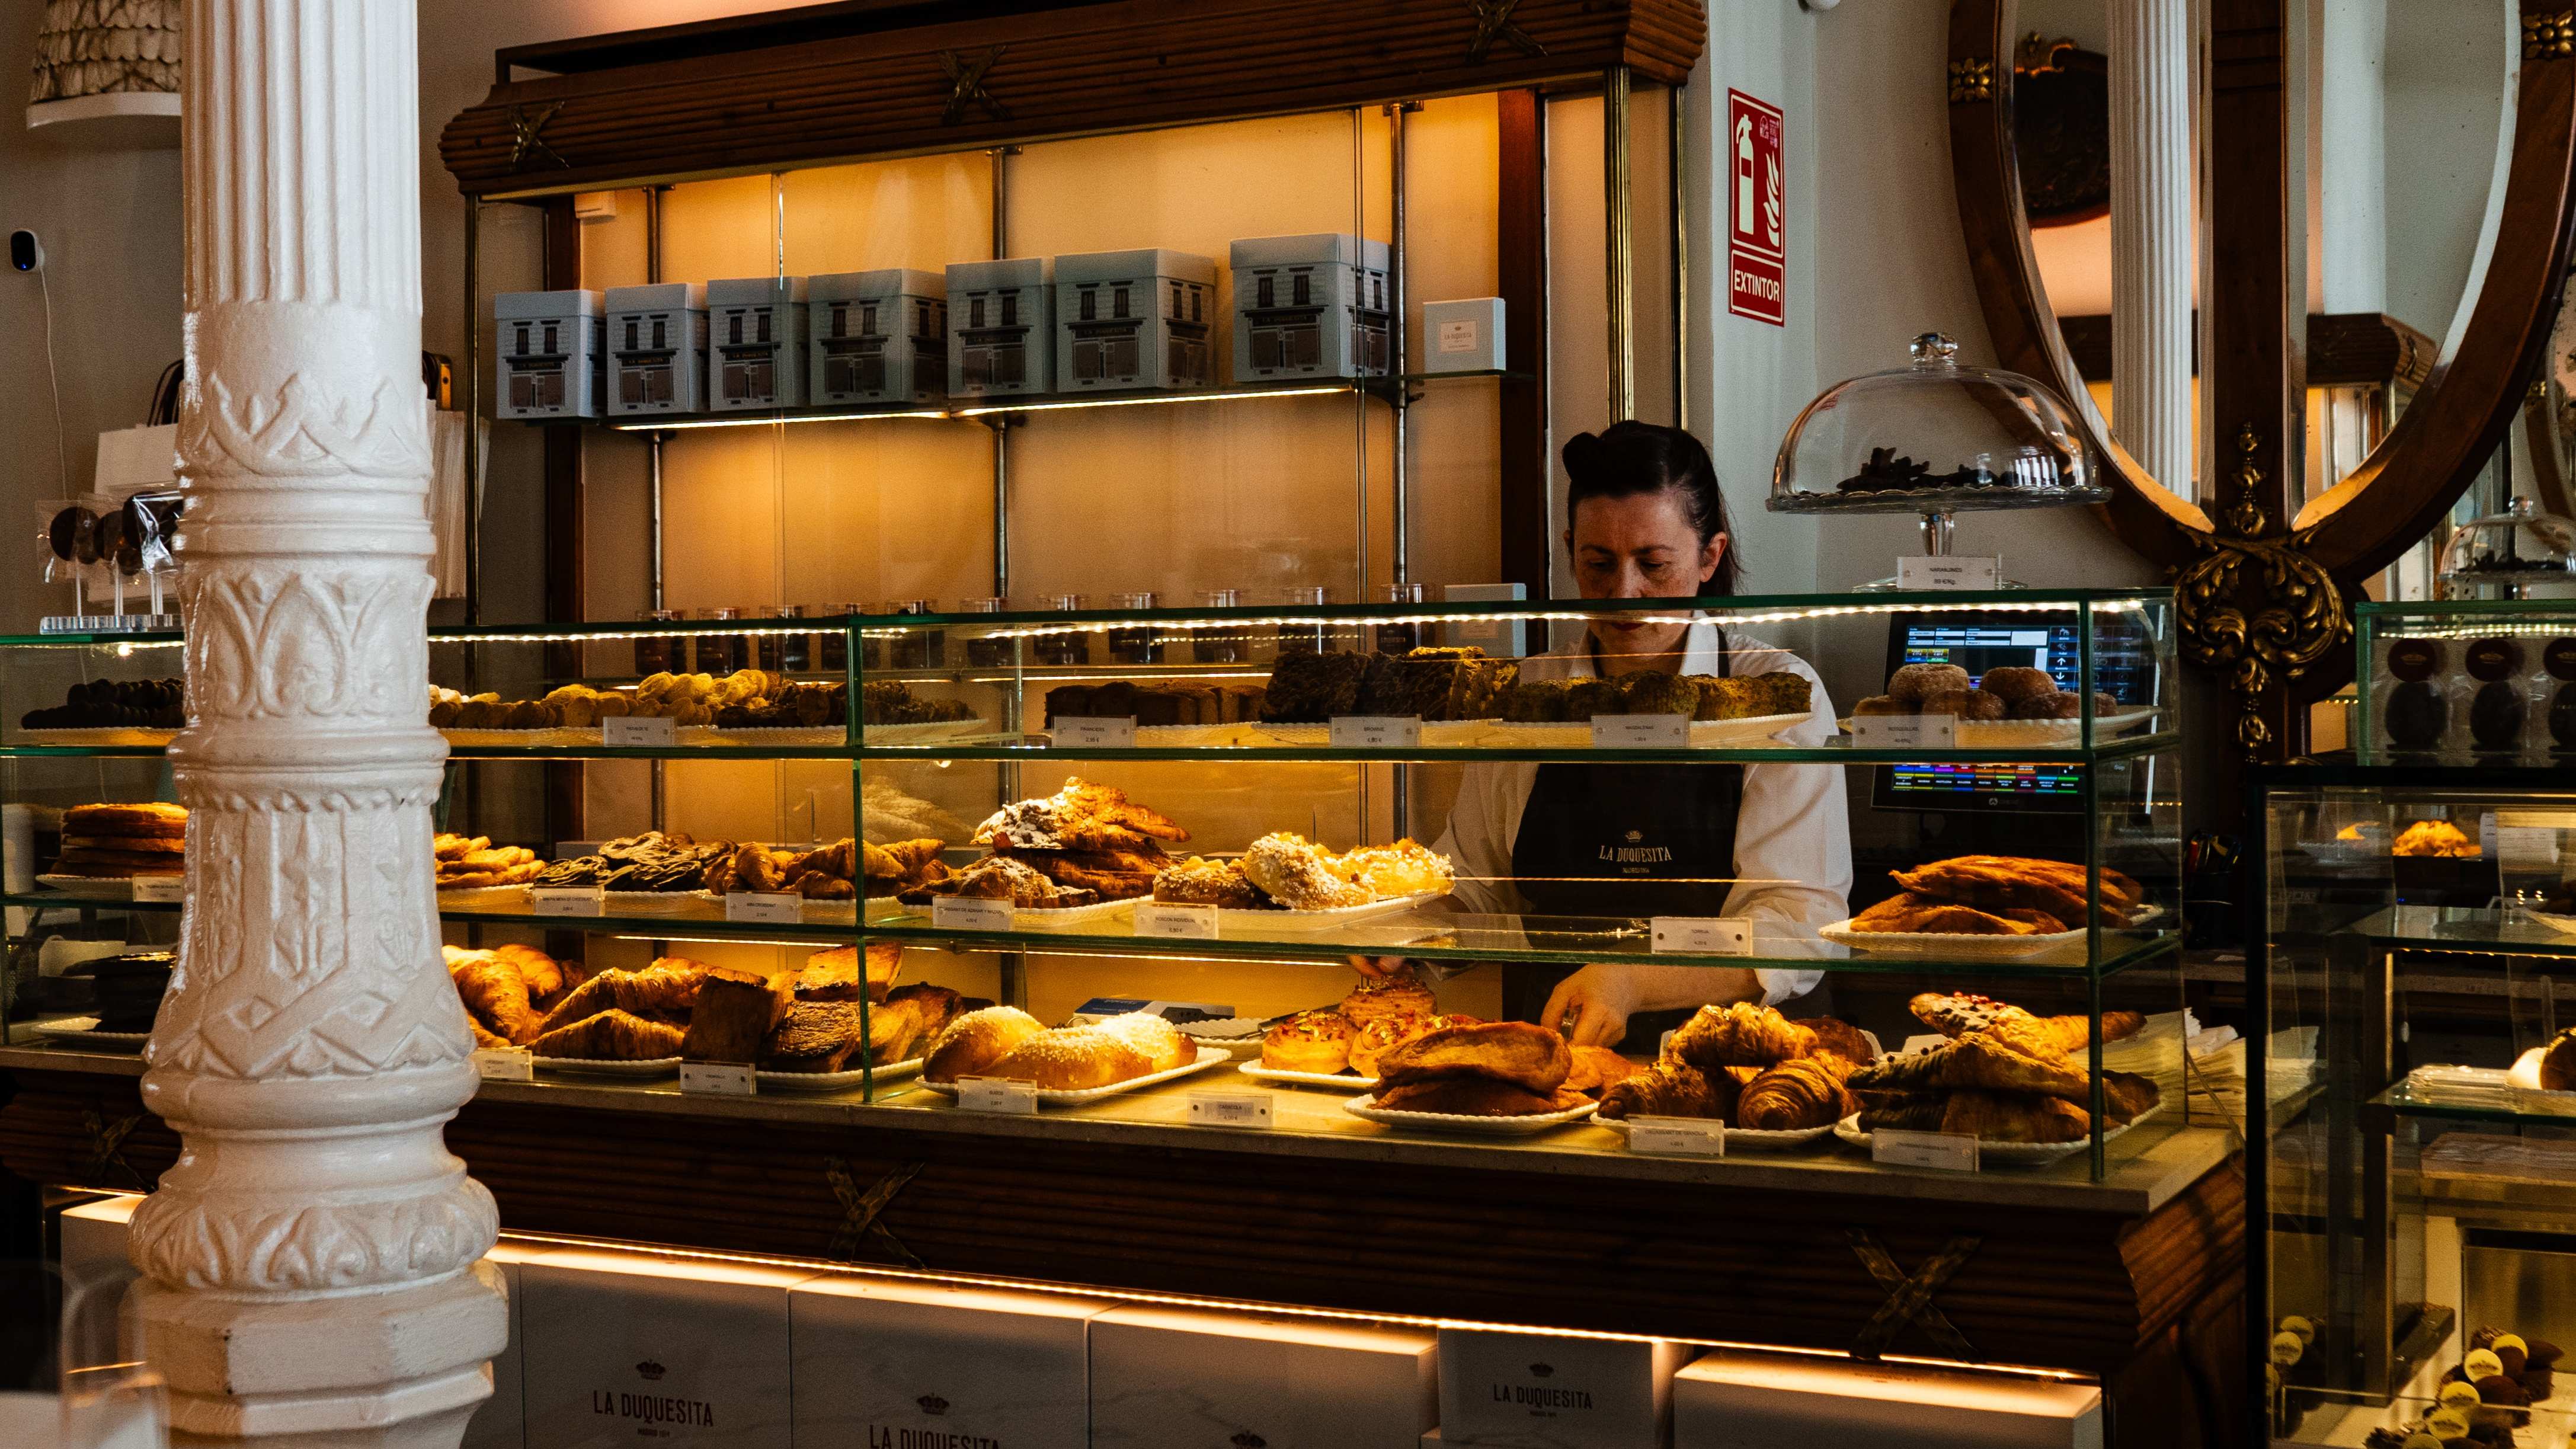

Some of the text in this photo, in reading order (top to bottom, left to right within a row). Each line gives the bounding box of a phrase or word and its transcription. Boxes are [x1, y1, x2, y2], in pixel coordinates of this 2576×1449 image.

[1734, 268, 1780, 303] EXTINTOR
[1598, 845, 1672, 863] LA DUQUESITA
[593, 1390, 713, 1428] LA DUQUESITA
[1494, 1384, 1592, 1410] LA DUQUESITA
[869, 1424, 892, 1449] LA
